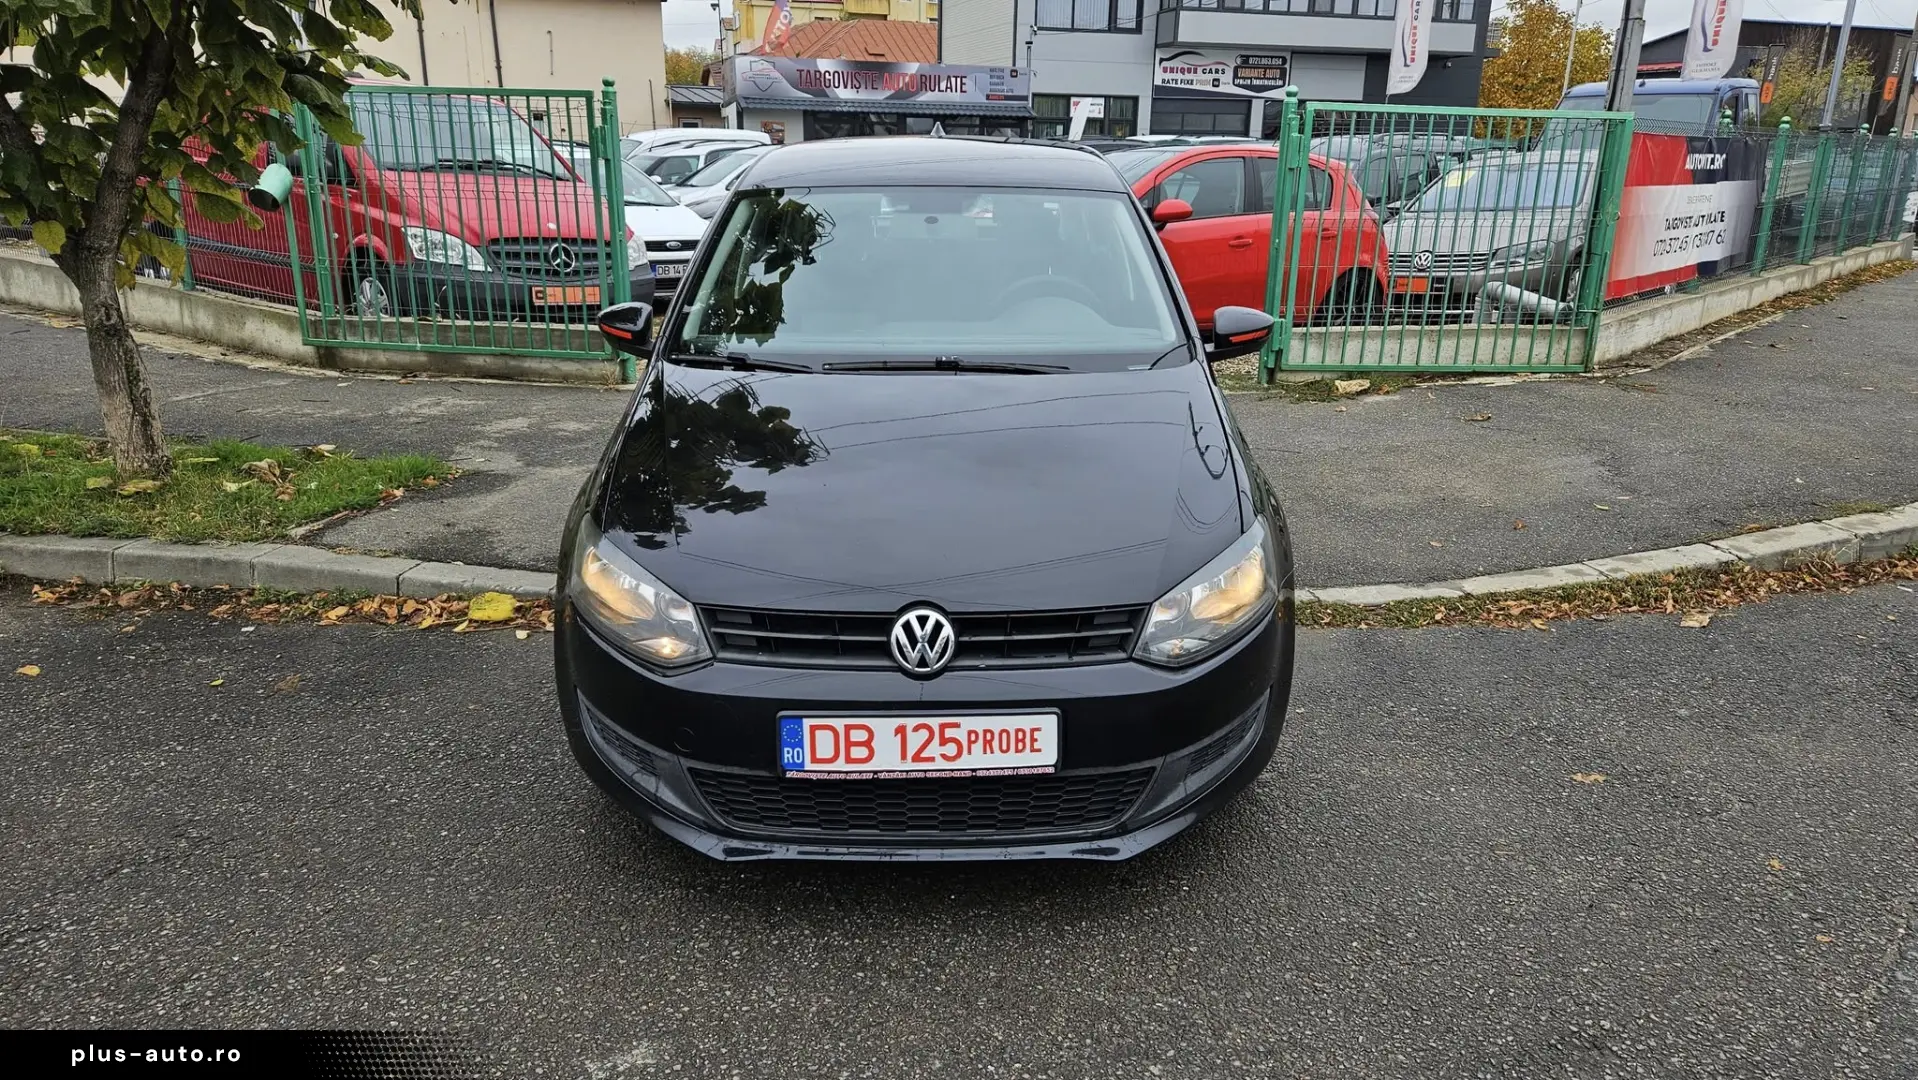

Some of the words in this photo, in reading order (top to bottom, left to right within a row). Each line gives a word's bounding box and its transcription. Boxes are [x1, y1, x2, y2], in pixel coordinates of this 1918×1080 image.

[1162, 66, 1198, 75] UNIQUE
[1202, 67, 1226, 75] CARS
[882, 71, 917, 92] AUTO
[920, 74, 967, 93] RULATE
[1180, 78, 1194, 86] FIXE
[657, 265, 670, 276] DB
[809, 723, 875, 765] DB
[894, 721, 964, 764] 125
[967, 727, 1043, 756] PROBE
[784, 747, 802, 763] RO
